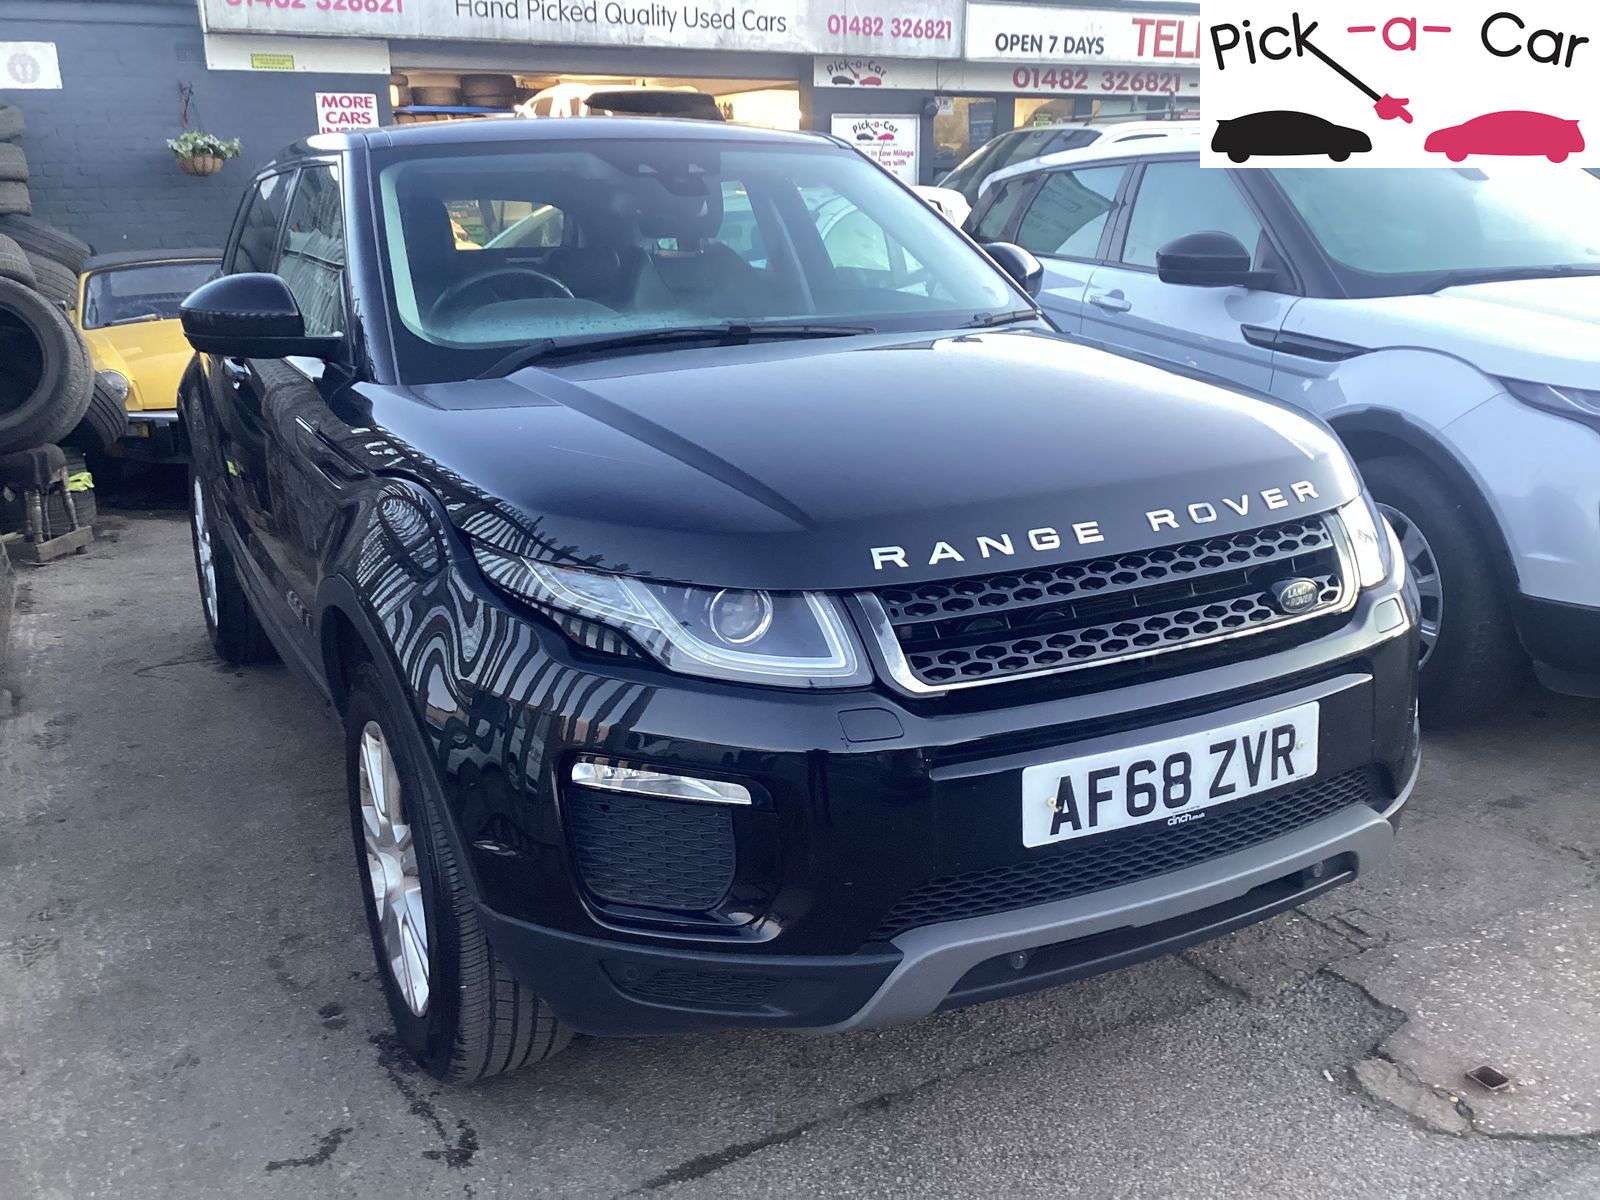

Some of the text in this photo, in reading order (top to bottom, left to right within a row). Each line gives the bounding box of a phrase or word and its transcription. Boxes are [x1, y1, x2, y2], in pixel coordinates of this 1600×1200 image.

[455, 0, 787, 32] Hand Picked Quality Used Cars
[827, 14, 952, 40] 01482 326821
[995, 32, 1105, 55] OPEN 7 DAYS
[1012, 66, 1181, 92] 01482 326821
[321, 95, 374, 109] MORE
[326, 111, 372, 124] CARS
[869, 480, 1320, 570] RANGE ROVER
[1049, 723, 1297, 836] AF68 ZVR
